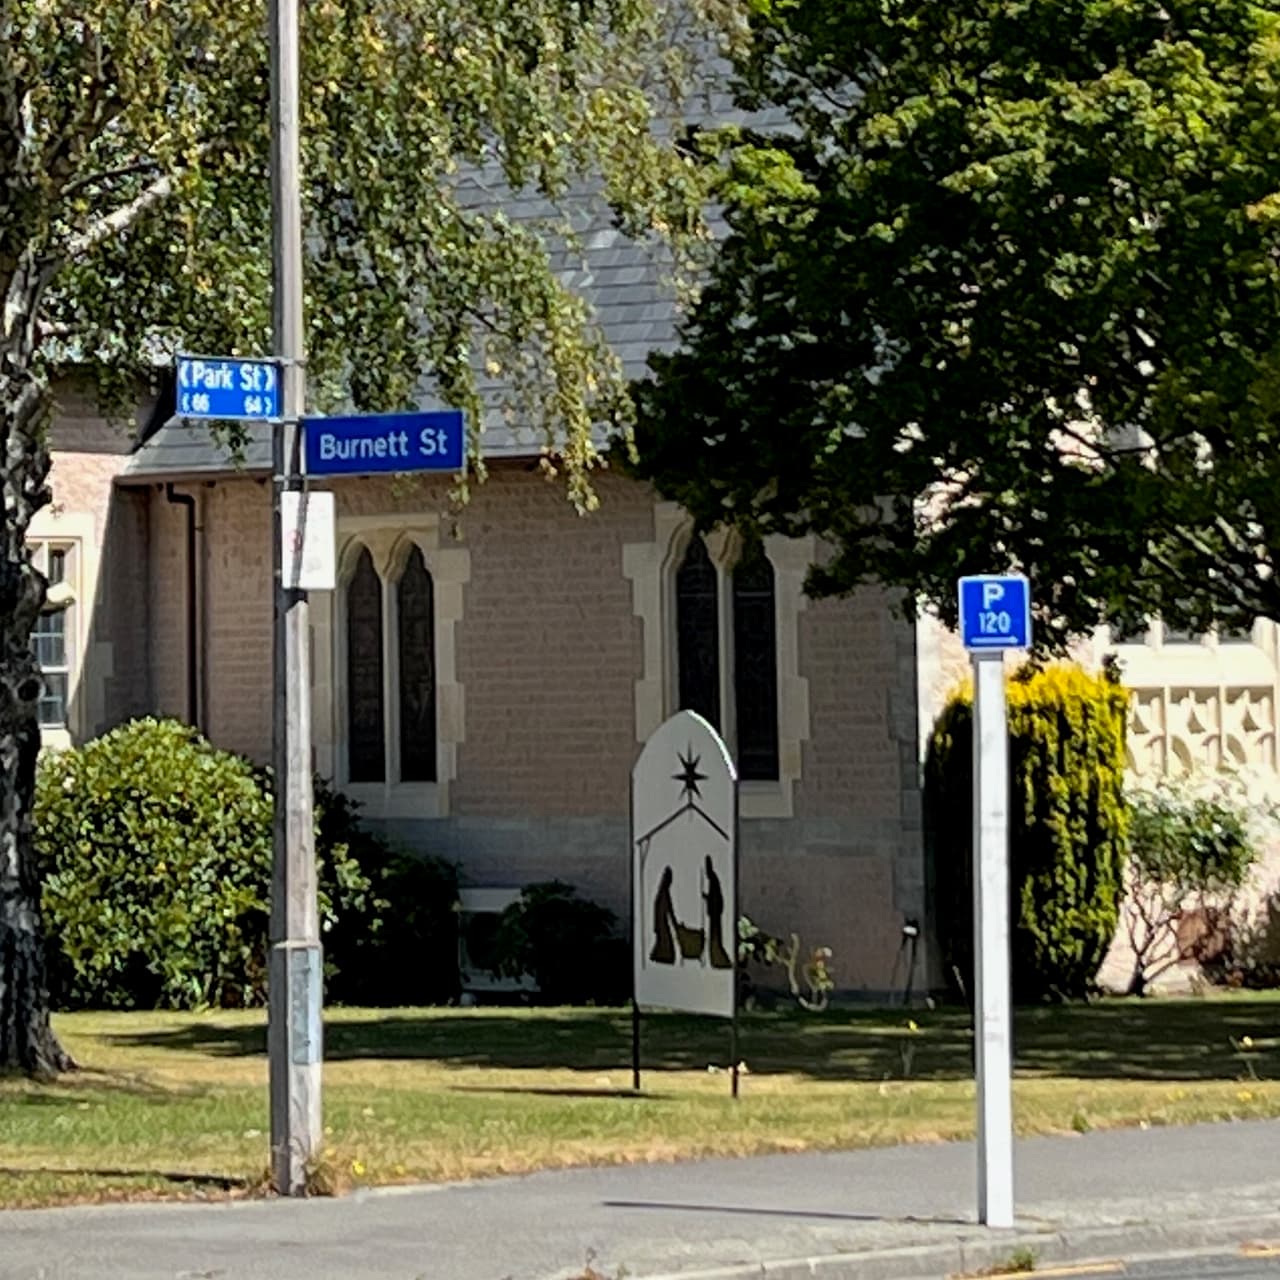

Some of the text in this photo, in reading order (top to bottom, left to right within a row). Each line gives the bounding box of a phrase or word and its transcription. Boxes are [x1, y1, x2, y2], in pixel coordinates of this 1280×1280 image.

[191, 360, 261, 391] Park St
[320, 428, 448, 460] Burnett St
[983, 583, 1005, 609] P
[979, 611, 1011, 634] 120
